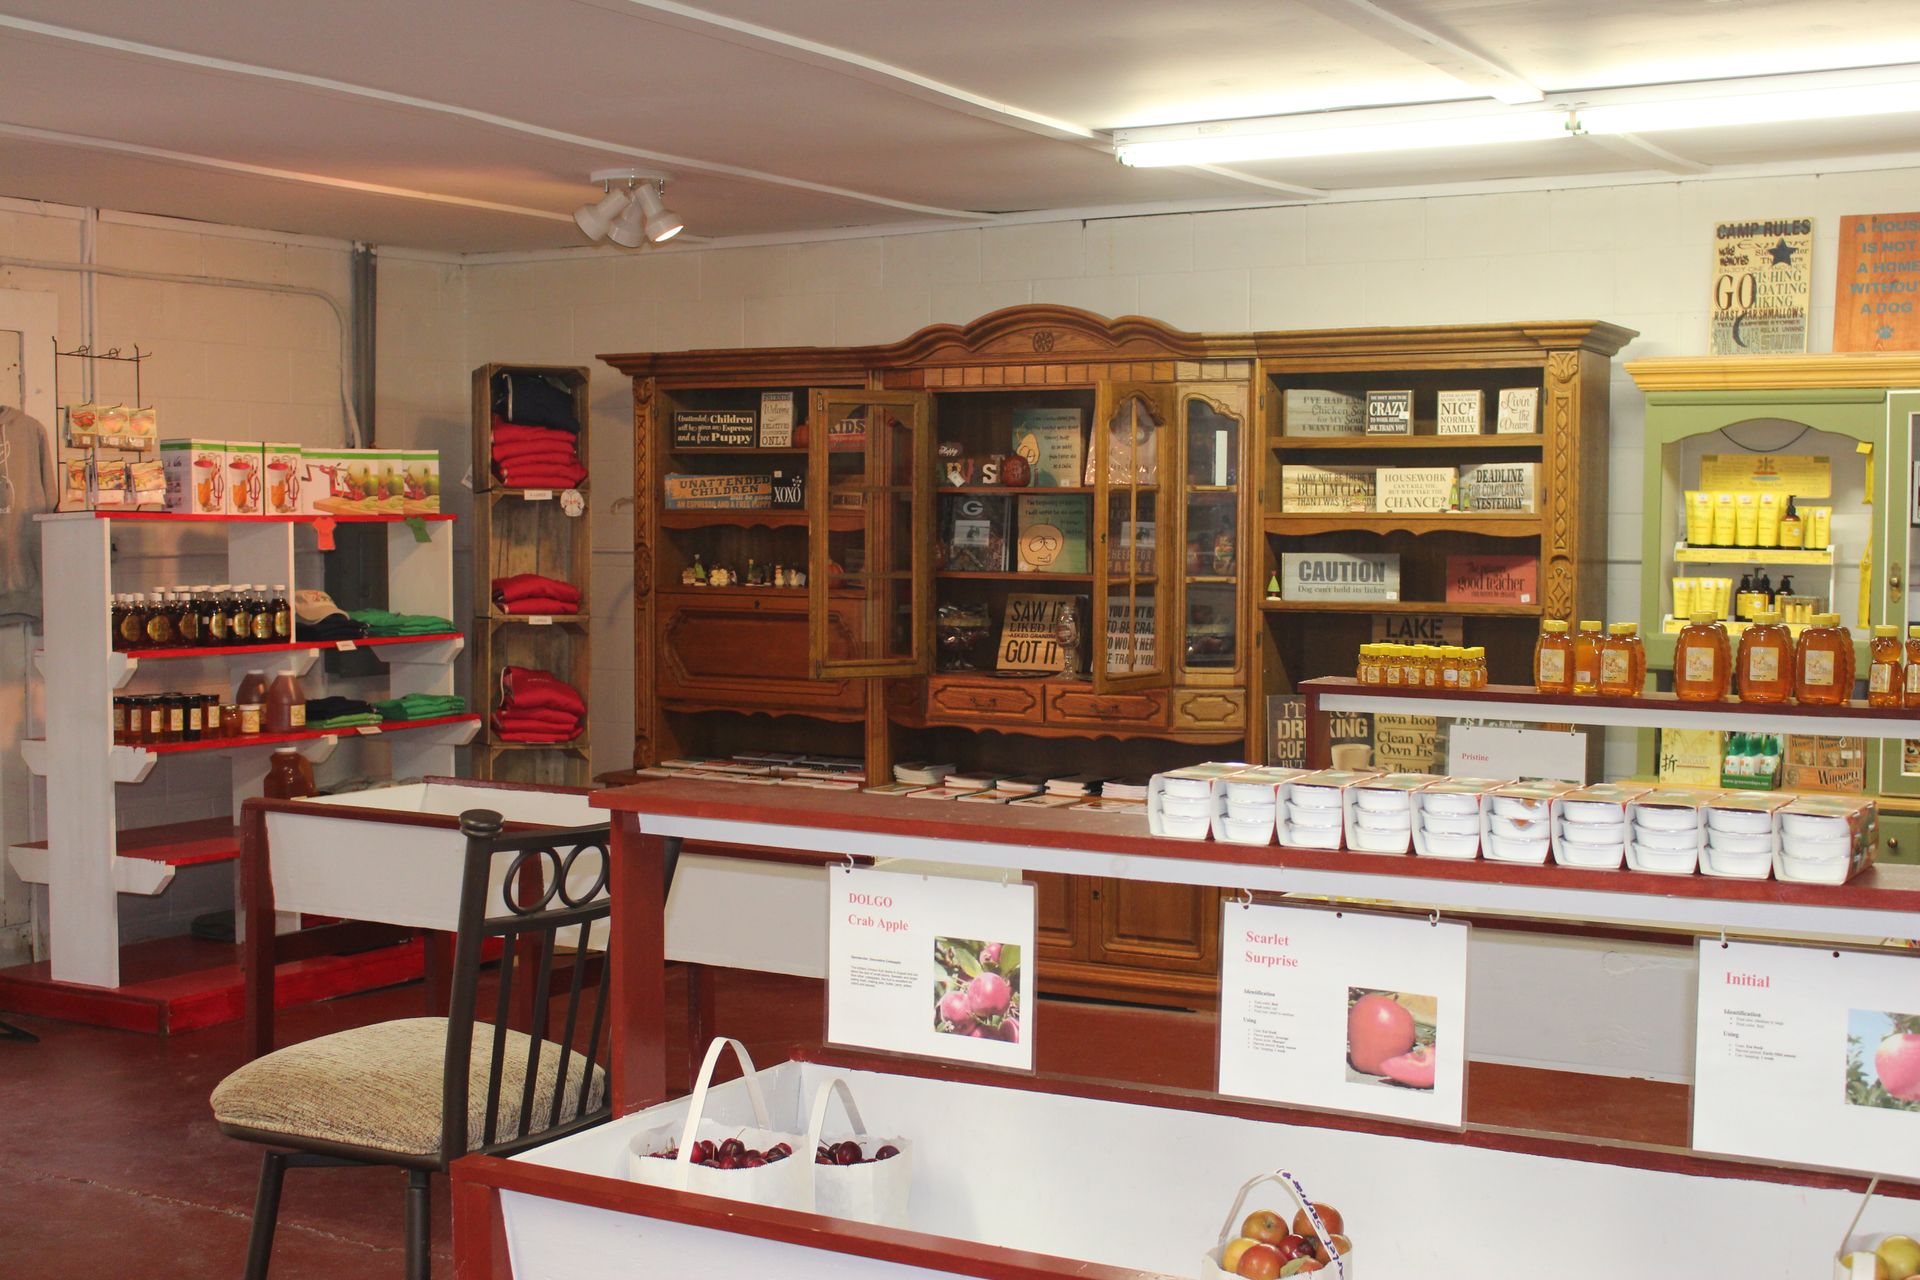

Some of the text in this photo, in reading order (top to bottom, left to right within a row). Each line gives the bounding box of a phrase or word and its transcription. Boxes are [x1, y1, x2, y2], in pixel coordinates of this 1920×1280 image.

[1717, 219, 1811, 239] CAMP RULES
[1856, 223, 1867, 233] A
[1862, 240, 1917, 254] IS NOT
[1857, 261, 1920, 274] A HOME
[1715, 272, 1758, 311] GO
[1757, 282, 1807, 296] OATING
[1850, 279, 1920, 295] WITHOU
[1714, 307, 1804, 322] ROAST MARSHMALLOWS
[1860, 302, 1913, 315] A DOG
[1739, 320, 1770, 328] AMPFIRE
[1324, 396, 1344, 406] HAD
[1312, 404, 1367, 416] Chicken Sou
[1369, 401, 1407, 417] CRAZY
[710, 414, 753, 424] Children
[1344, 415, 1364, 425] Soul
[1440, 415, 1475, 424] NORMAL
[722, 425, 753, 433] Espresso
[1306, 424, 1331, 432] WANT
[1333, 424, 1366, 433] CHOCOL
[1440, 424, 1475, 433] FAMILY
[678, 433, 690, 442] and
[711, 432, 752, 444] Puppy
[762, 436, 788, 446] ONLY
[680, 475, 771, 489] UNATTENDED
[1301, 473, 1316, 483] MAY
[1319, 473, 1332, 483] NOT
[1334, 473, 1343, 482] BE
[1384, 473, 1446, 482] HOUSEWORK
[1476, 468, 1524, 483] DEADLINE
[690, 484, 760, 497] CHILDREN
[774, 485, 802, 503] XOXO
[1298, 483, 1318, 496] BUT
[1341, 483, 1376, 497] CLOSE
[1482, 483, 1525, 497] COMPLAINTS
[1298, 497, 1317, 507] THAN
[1323, 497, 1339, 507] WAS
[1384, 496, 1447, 508] CHANCE?
[1476, 497, 1522, 510] YESTERDAY
[1107, 549, 1131, 560] CHEE
[1299, 560, 1385, 583] CAUTION
[1457, 574, 1526, 592] good teacher
[1298, 585, 1313, 595] Dog
[1315, 586, 1333, 594] can't
[1335, 585, 1352, 594] hold
[1365, 586, 1385, 594] licker
[1011, 600, 1048, 622] SAW
[1109, 605, 1145, 618] YOU DN'T
[1009, 623, 1046, 633] LIKED
[1135, 622, 1155, 635] CRAZ
[1386, 617, 1444, 639] LAKE
[1114, 638, 1139, 651] WOK
[1140, 639, 1155, 651] HER
[1005, 639, 1042, 664] GOT
[1115, 653, 1138, 665] TRAN
[1379, 714, 1436, 726] own hoo
[1377, 731, 1436, 745] Clean Yo
[1278, 740, 1306, 759] COF
[1380, 744, 1434, 757] Own Fis
[1462, 752, 1489, 762] Pristine
[848, 892, 893, 908] DOLGO
[848, 914, 909, 933] Crab Apple
[1246, 930, 1289, 946] Scarlet
[1245, 950, 1298, 968] Surprise
[1725, 971, 1770, 988] Initial
[1723, 1008, 1762, 1018] Identification
[1723, 1030, 1740, 1039] Using
